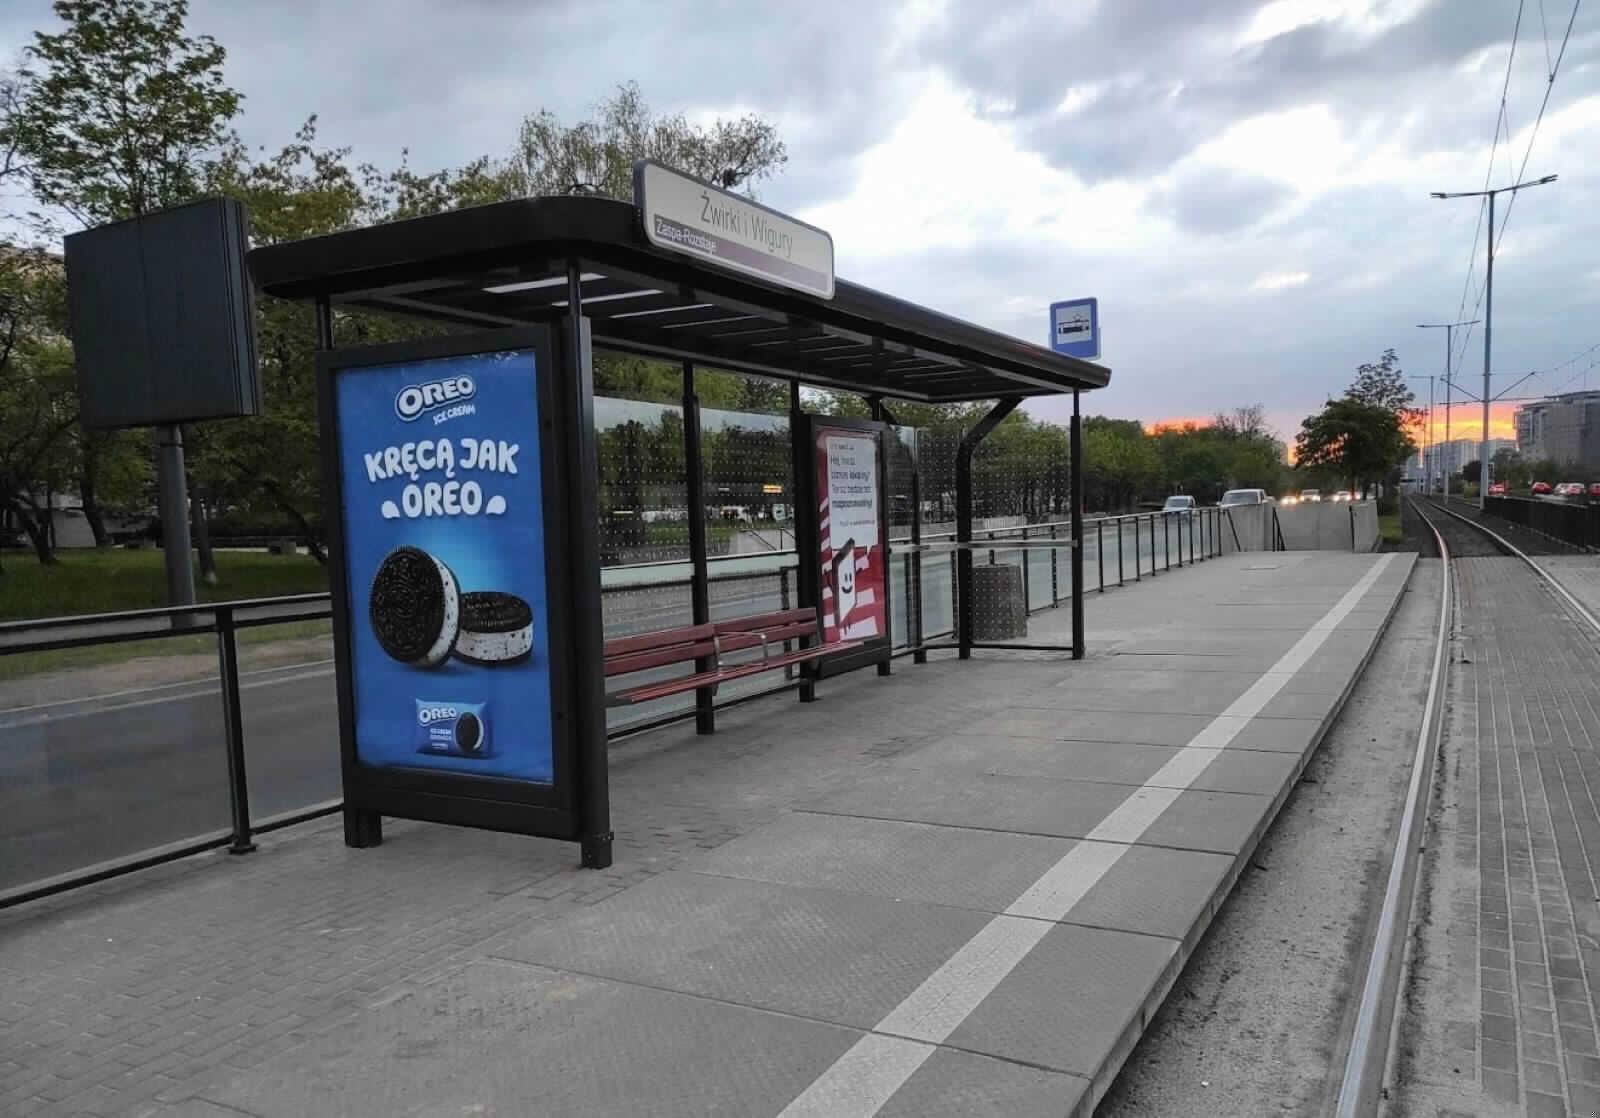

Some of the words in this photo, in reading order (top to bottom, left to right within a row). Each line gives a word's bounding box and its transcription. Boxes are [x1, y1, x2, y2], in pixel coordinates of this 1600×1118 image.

[700, 191, 740, 233] Żwirki
[743, 214, 748, 236] i
[751, 215, 793, 258] Wigury
[397, 376, 473, 415] OREO
[433, 410, 448, 425] ICE
[447, 404, 476, 418] CREAM
[364, 438, 455, 482] KRĘCĄ
[459, 438, 519, 474] JAK
[402, 480, 482, 518] OREO
[419, 707, 457, 723] OREO
